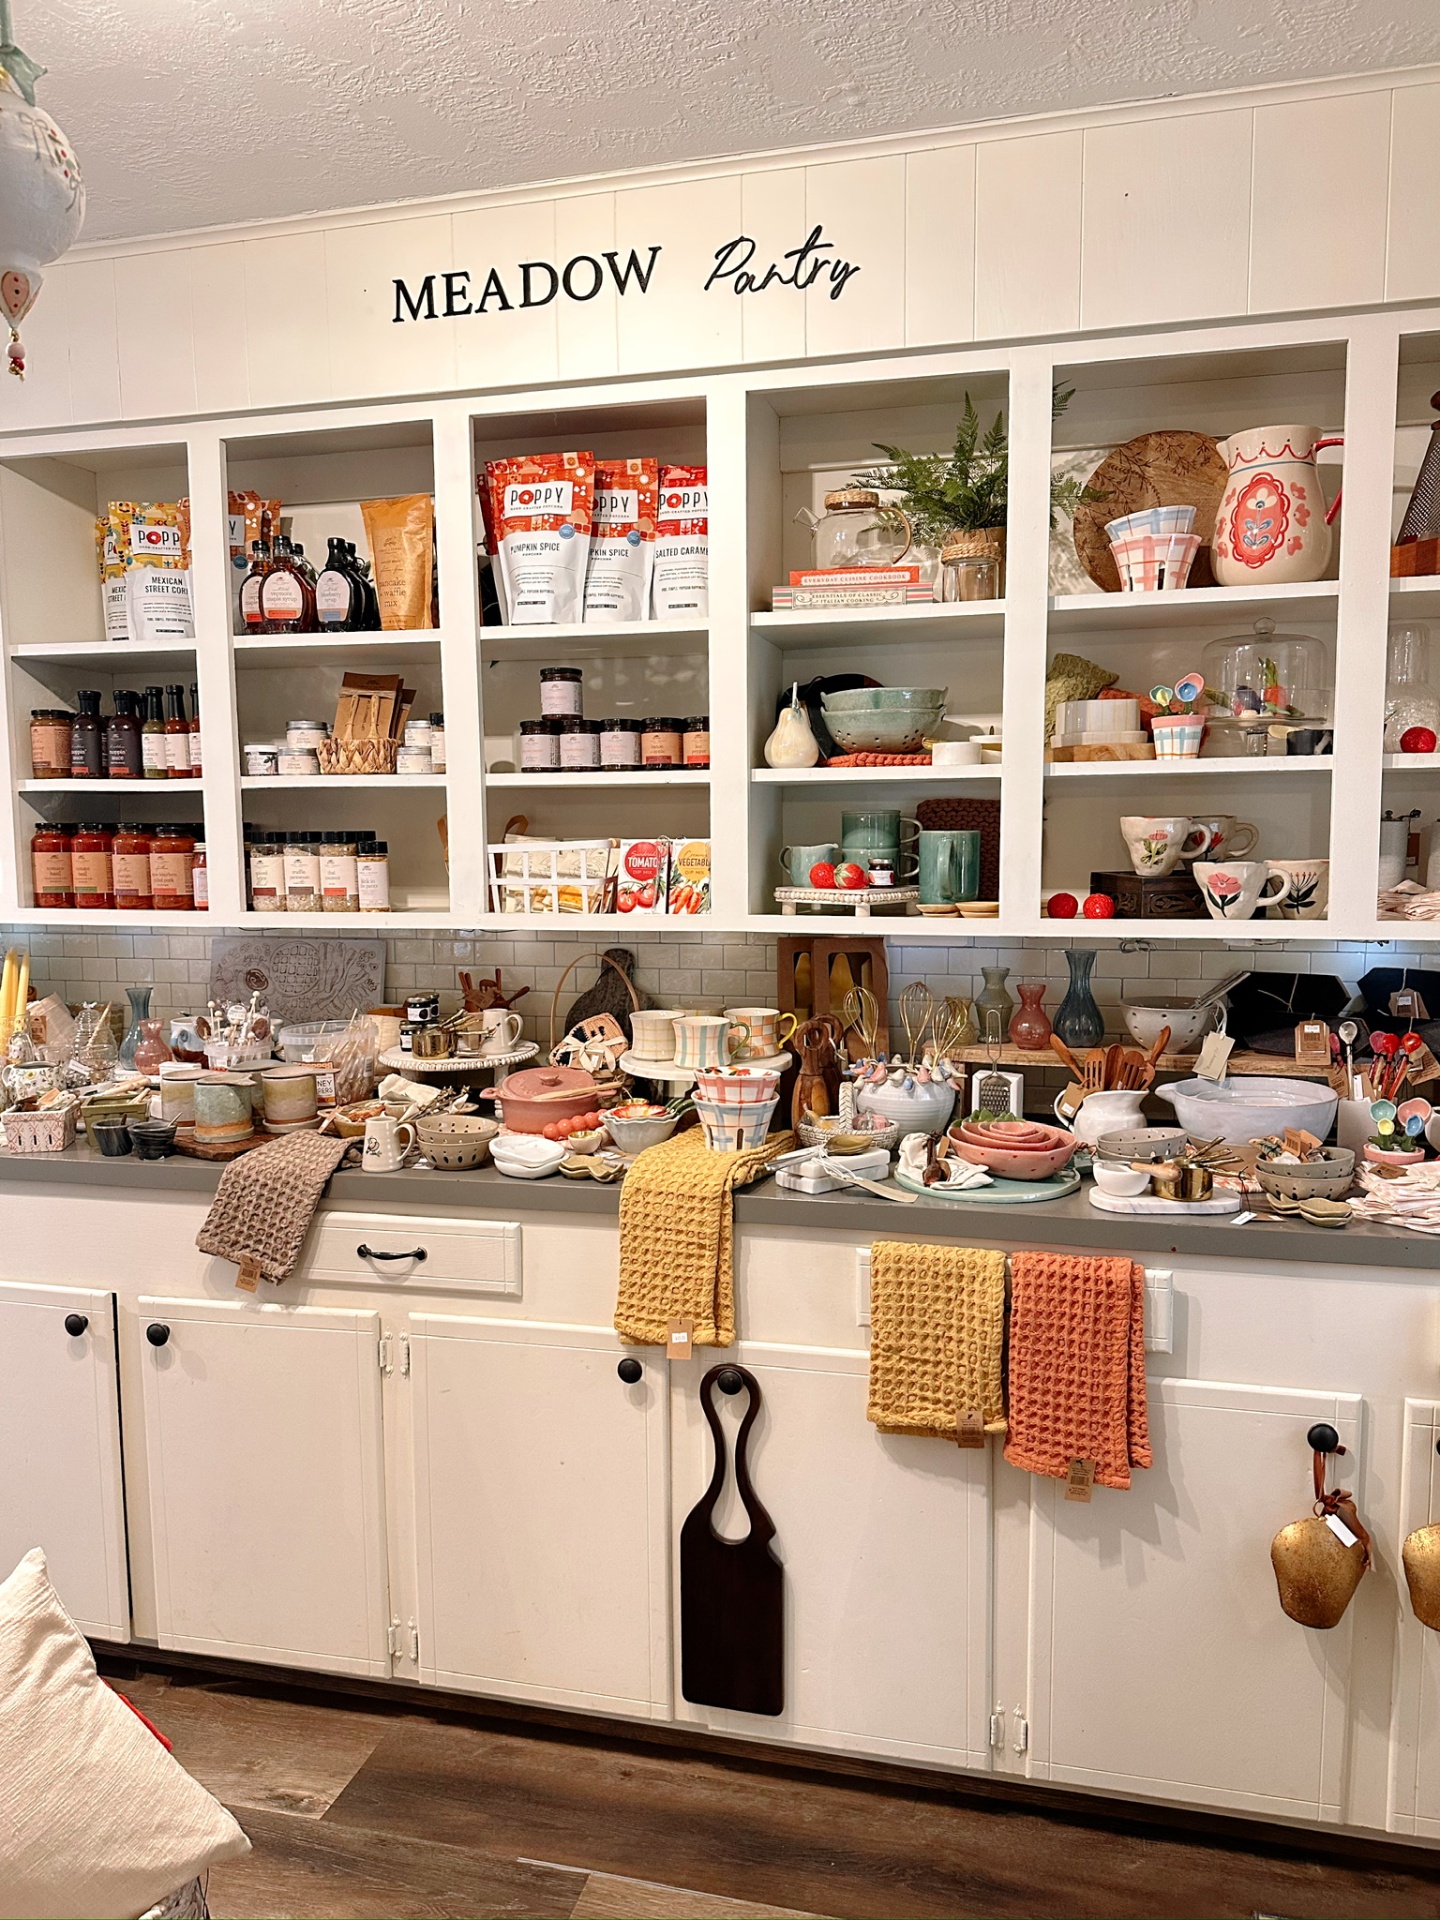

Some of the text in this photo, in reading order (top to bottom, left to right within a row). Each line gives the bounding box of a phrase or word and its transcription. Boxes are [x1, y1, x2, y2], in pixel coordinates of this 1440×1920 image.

[392, 225, 861, 323] MEADOW Pantry
[510, 487, 564, 506] POPPY
[593, 496, 629, 512] PPY
[138, 530, 180, 546] POPP
[540, 542, 560, 551] SPICE
[655, 546, 708, 558] SALTED CARAME
[589, 548, 629, 557] PKIN SPICE
[151, 576, 183, 585] MEXICAN
[869, 573, 907, 581] COOKBOOK
[628, 857, 658, 868] TOMATO
[679, 859, 709, 867] VEGETABL
